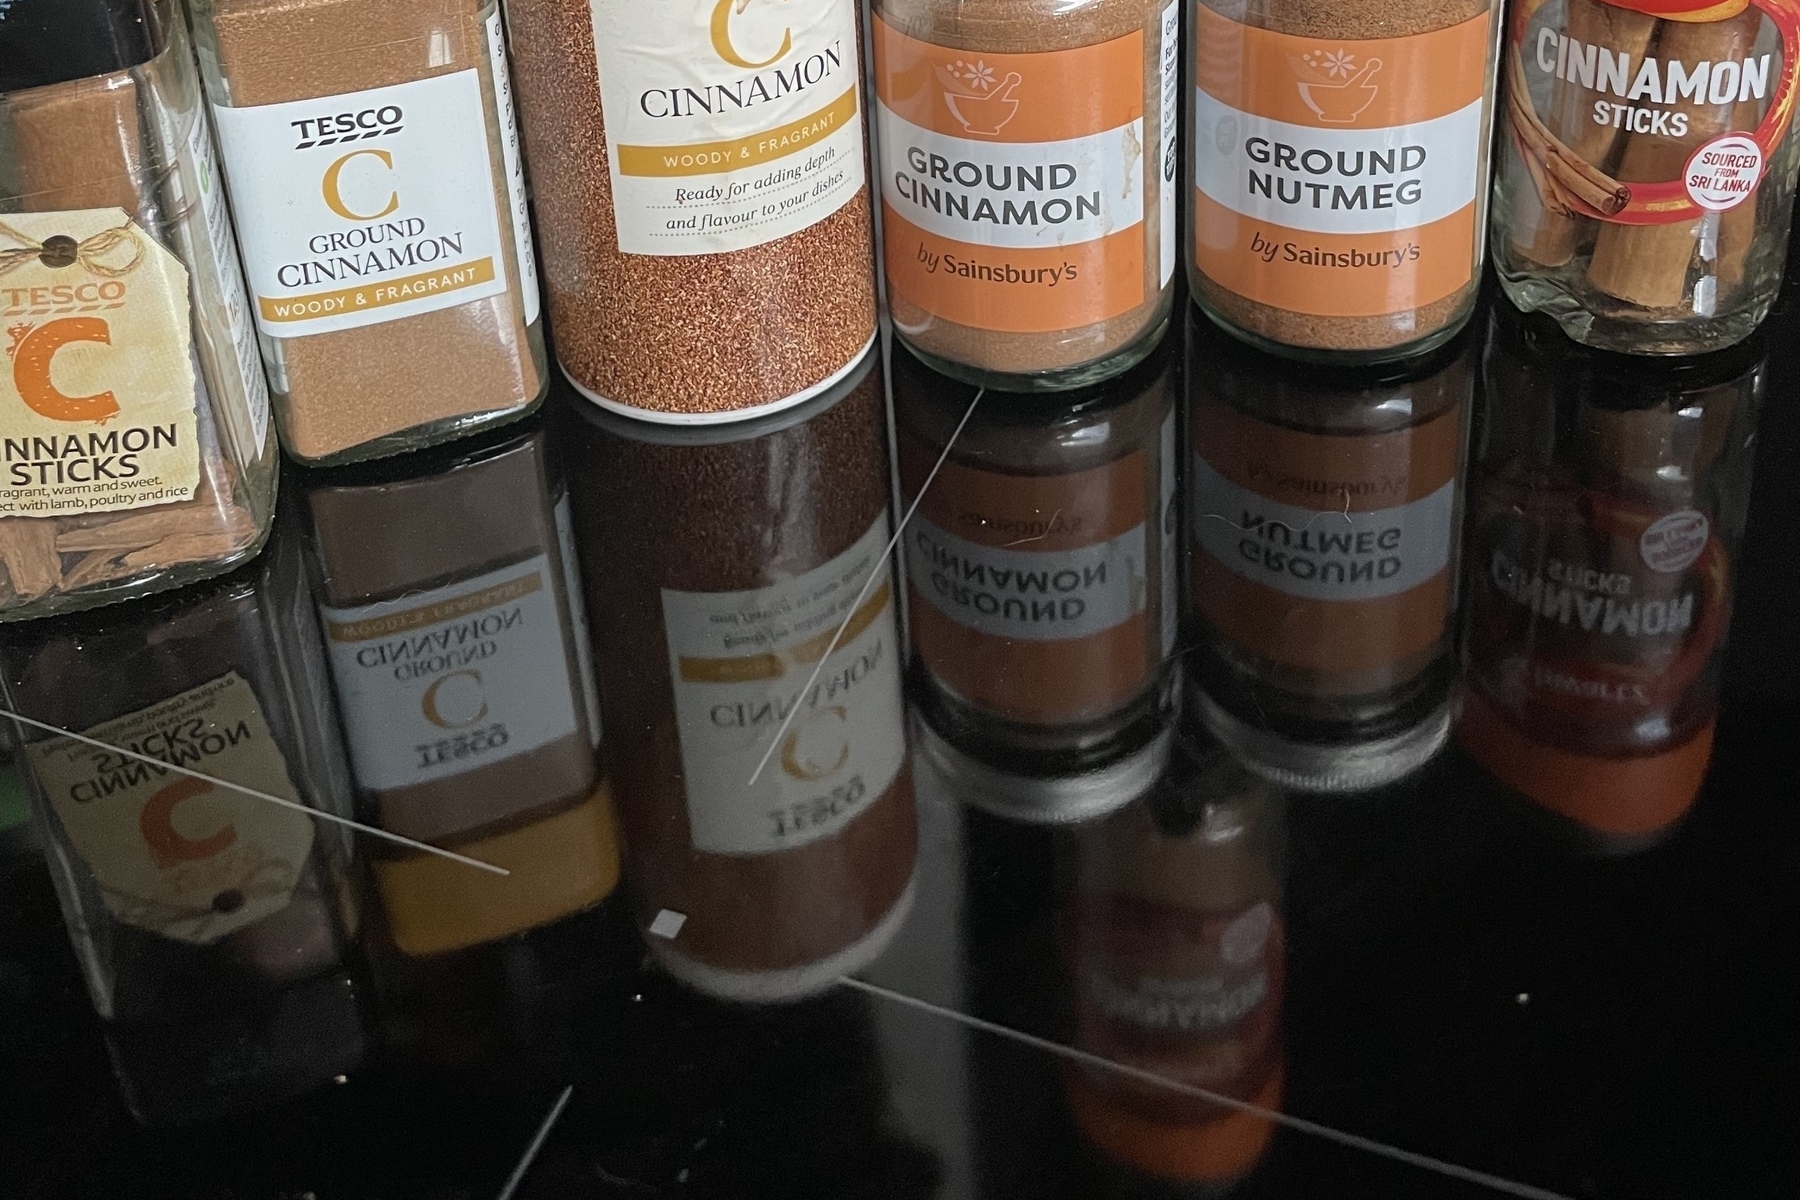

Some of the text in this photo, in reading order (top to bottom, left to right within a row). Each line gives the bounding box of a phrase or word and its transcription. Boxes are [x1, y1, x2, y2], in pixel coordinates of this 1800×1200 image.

[640, 40, 843, 119] CINNAMON
[1536, 27, 1771, 105] CINNAMON
[291, 105, 404, 140] TESCO
[663, 111, 836, 168] WOODY & FRAGRANT
[1592, 100, 1689, 138] STICKS
[675, 146, 836, 202] Ready for adding depth
[907, 146, 1078, 192] GROUND
[1245, 137, 1427, 177] GROUND
[1702, 152, 1758, 169] SOURCED
[1714, 168, 1739, 178] FROM
[321, 147, 400, 222] C
[666, 170, 844, 232] and flavour to your dishes
[895, 170, 1101, 226] CINNAMON
[1248, 168, 1423, 211] NUTMEG
[1689, 175, 1751, 193] SRI LANKA
[309, 216, 426, 254] GROUND
[1250, 231, 1421, 269] by Sainsbury's
[277, 231, 463, 288] CINNAMON
[917, 242, 1079, 288] by Sainsbury's
[2, 280, 126, 307] TESCO
[274, 267, 477, 318] WOODY & FRAGRANT
[13, 316, 121, 423] C
[0, 423, 178, 462] NNAMON
[0, 476, 163, 500] ragrant, warm and sweet.
[10, 453, 141, 487] STICKS
[20, 498, 49, 511] with
[51, 497, 88, 510] lamb,
[90, 493, 136, 508] poultry
[138, 487, 163, 499] and
[165, 486, 189, 498] rice
